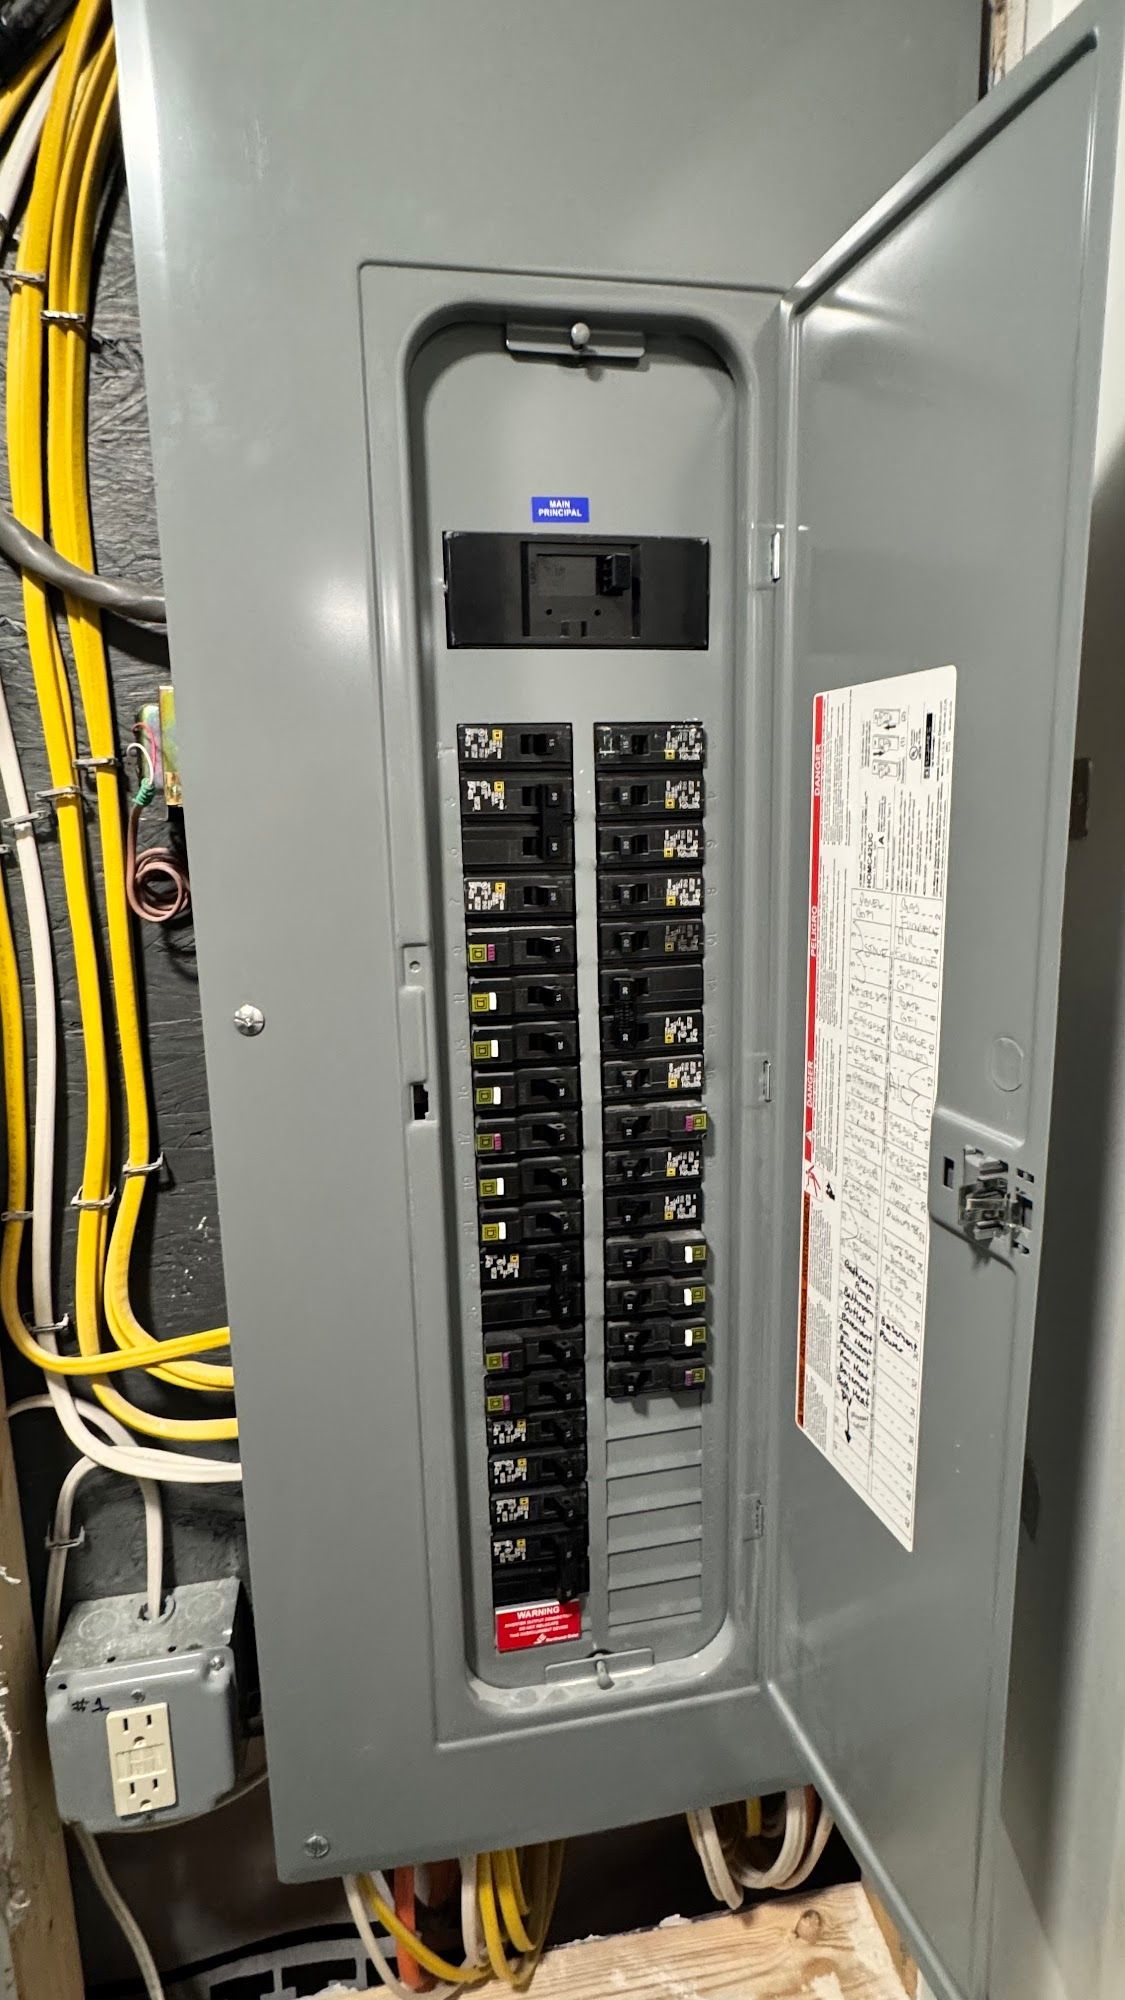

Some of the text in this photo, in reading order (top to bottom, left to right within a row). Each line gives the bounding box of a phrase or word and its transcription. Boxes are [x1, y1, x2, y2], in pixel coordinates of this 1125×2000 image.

[538, 508, 582, 517] PRINCIPAL
[549, 500, 571, 509] MAIN
[814, 743, 822, 797] DANGER
[866, 832, 874, 888] HOMC42UC
[810, 905, 818, 958] PELIGRO
[806, 1059, 814, 1109] DANGER
[844, 1258, 875, 1291] Bathroom
[843, 1286, 874, 1319] Bathroom
[844, 1301, 866, 1326] Outlet
[516, 1605, 560, 1620] WARNING
[71, 1696, 110, 1713] #1
